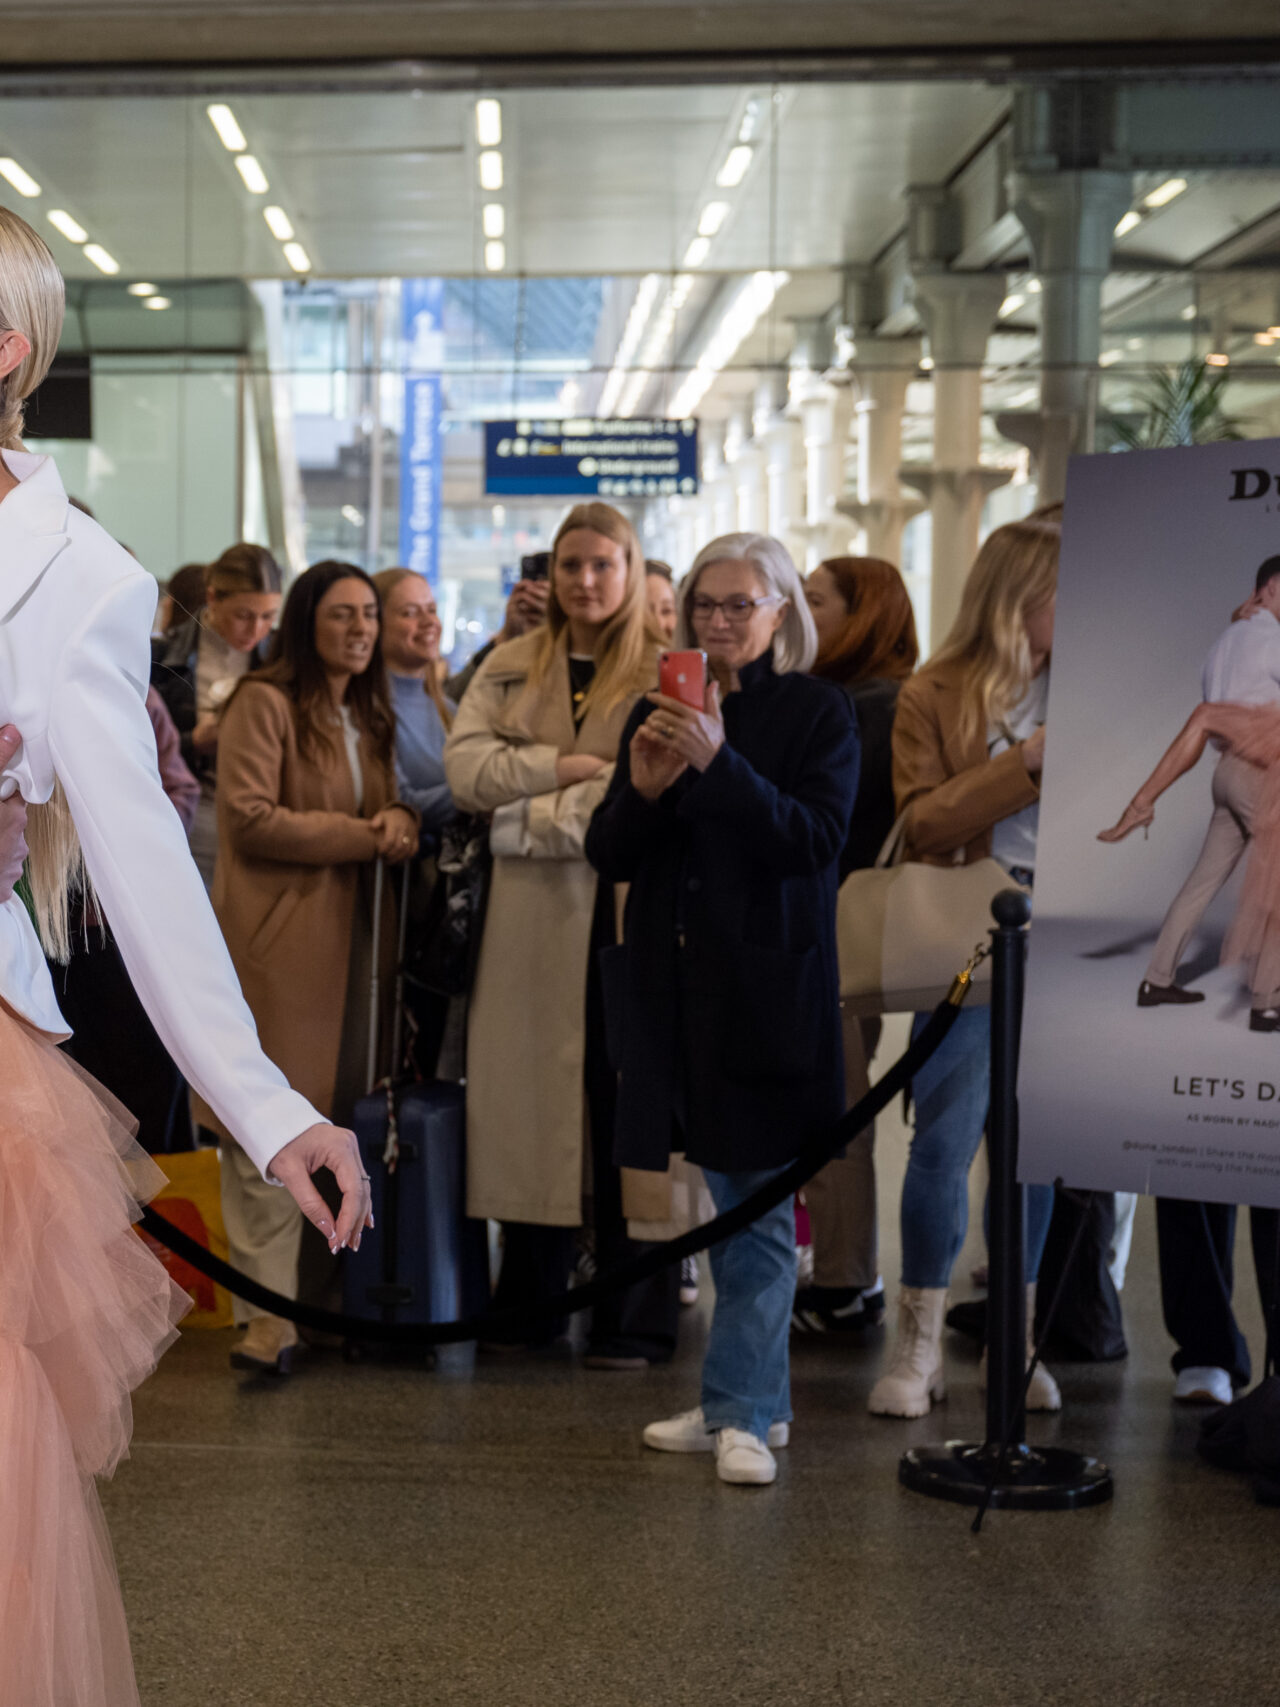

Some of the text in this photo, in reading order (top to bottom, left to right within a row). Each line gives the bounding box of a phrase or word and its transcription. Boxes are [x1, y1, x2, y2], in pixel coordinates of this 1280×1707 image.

[1228, 468, 1280, 501] D
[1186, 1113, 1200, 1123] AS
[1202, 1114, 1234, 1125] WORN
[1237, 1116, 1250, 1127] BY
[1206, 1146, 1235, 1158] Share
